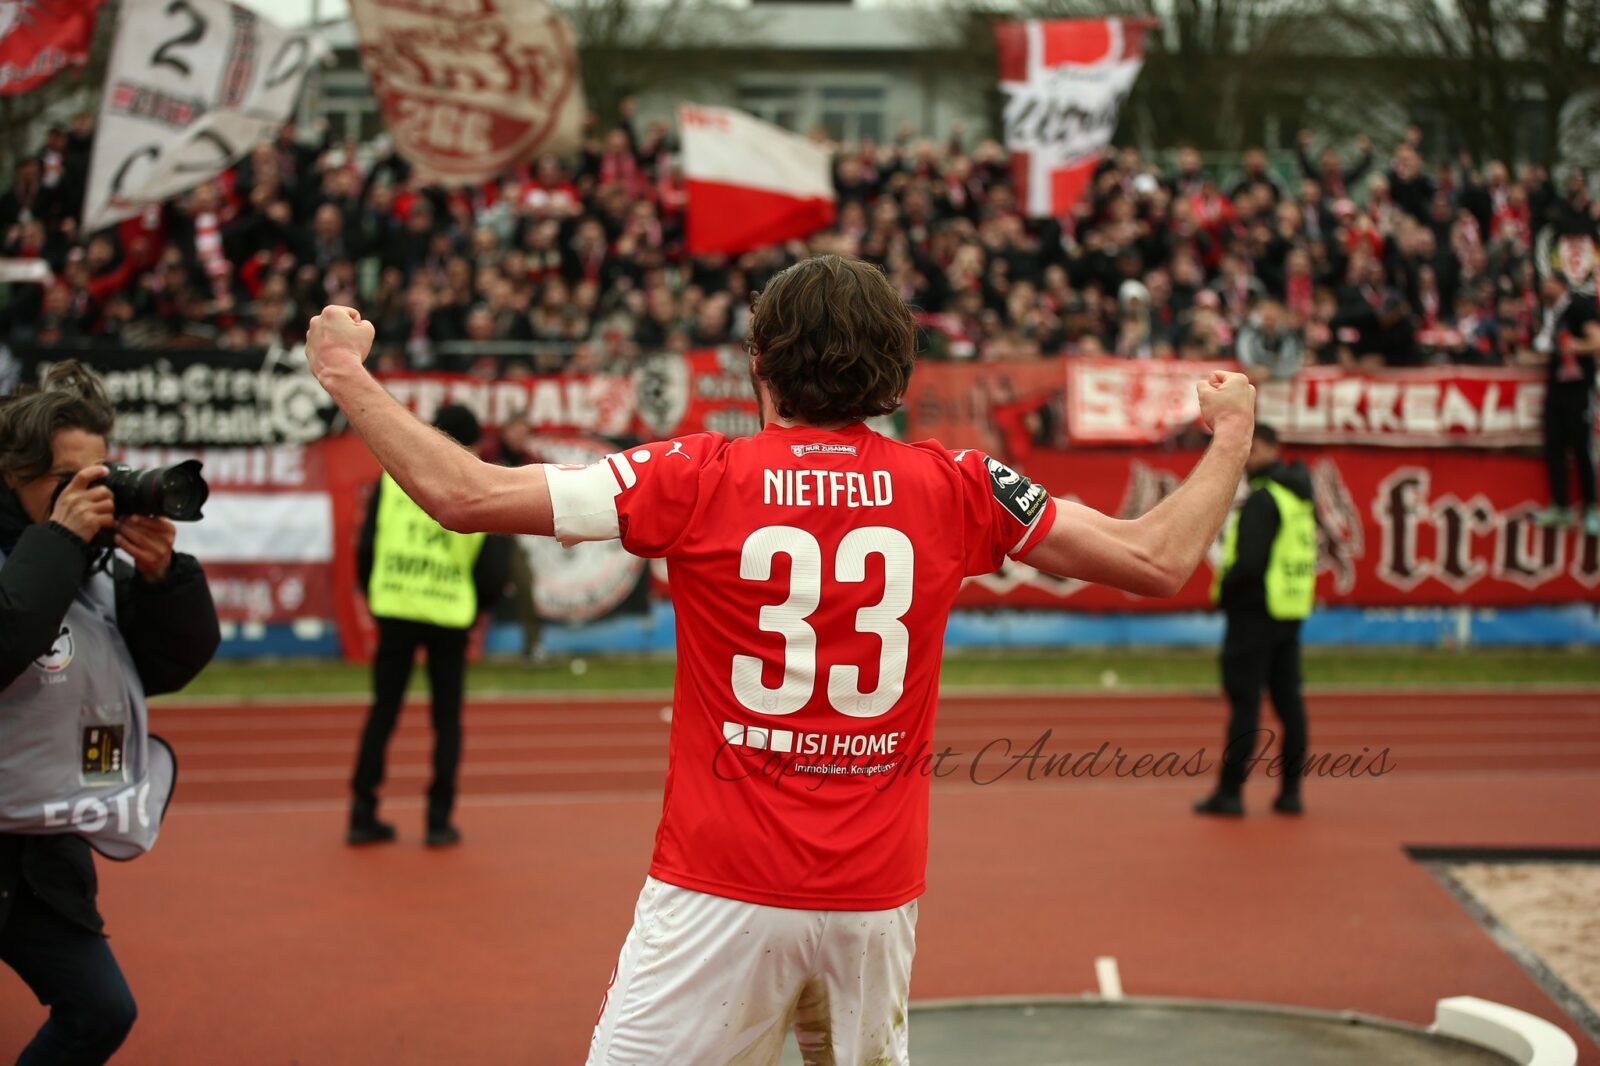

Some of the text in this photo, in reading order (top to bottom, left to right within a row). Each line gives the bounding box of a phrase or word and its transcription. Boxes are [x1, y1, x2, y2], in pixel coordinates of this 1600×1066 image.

[763, 468, 894, 508] NIETFELD
[730, 525, 916, 719] 33
[795, 732, 827, 756] ISI
